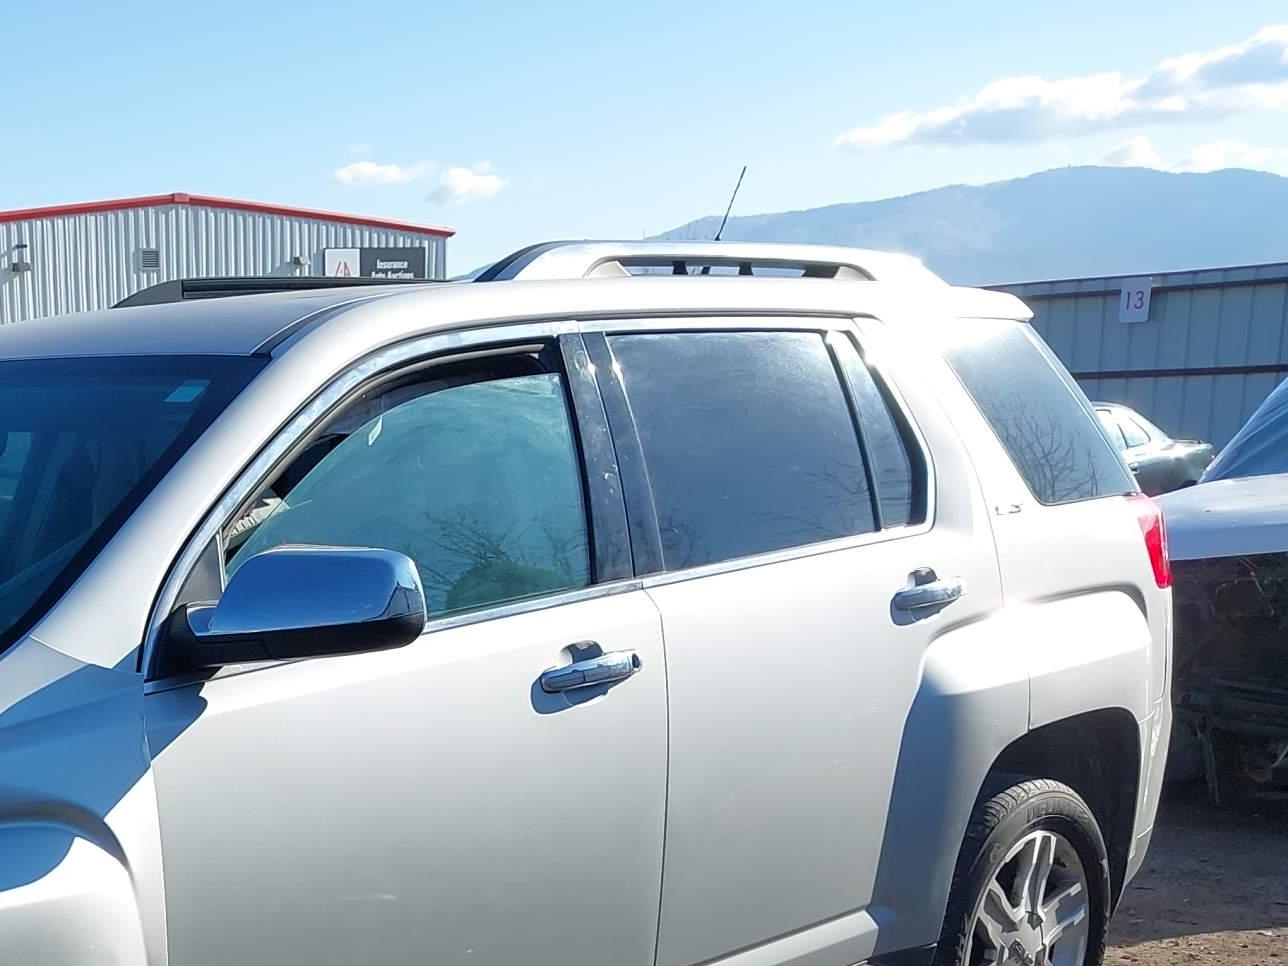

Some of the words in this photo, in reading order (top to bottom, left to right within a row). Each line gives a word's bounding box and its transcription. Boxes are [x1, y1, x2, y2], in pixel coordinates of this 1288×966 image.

[376, 259, 409, 270] Insurance
[371, 271, 386, 279] Auto
[387, 271, 415, 279] Auctions
[1125, 290, 1145, 310] 13
